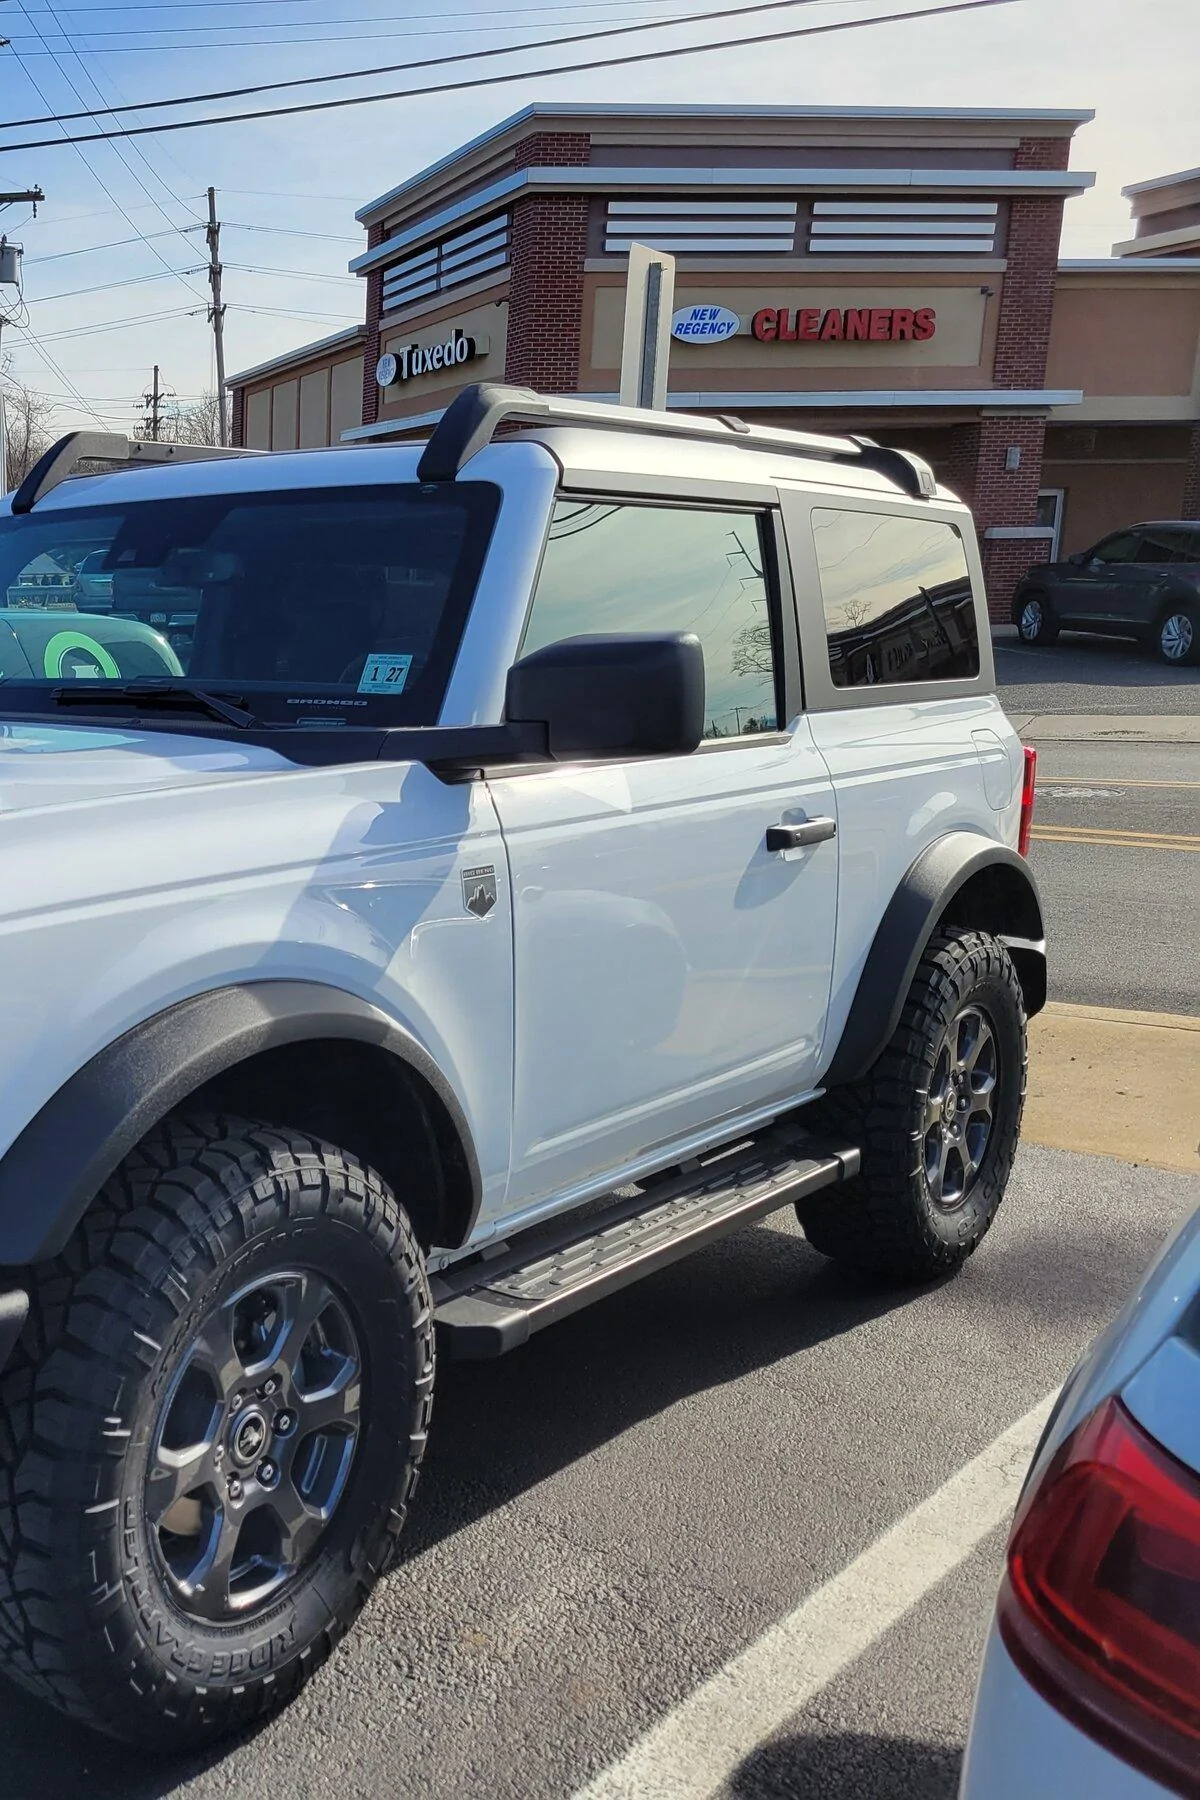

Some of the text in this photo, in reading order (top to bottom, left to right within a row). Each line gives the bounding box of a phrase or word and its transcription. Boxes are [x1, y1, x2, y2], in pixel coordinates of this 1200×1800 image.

[689, 308, 721, 321] NEW
[674, 322, 735, 335] REGENCY
[751, 307, 936, 342] CLEANERS
[400, 329, 469, 379] Tuxedo
[370, 666, 405, 682] 1 27
